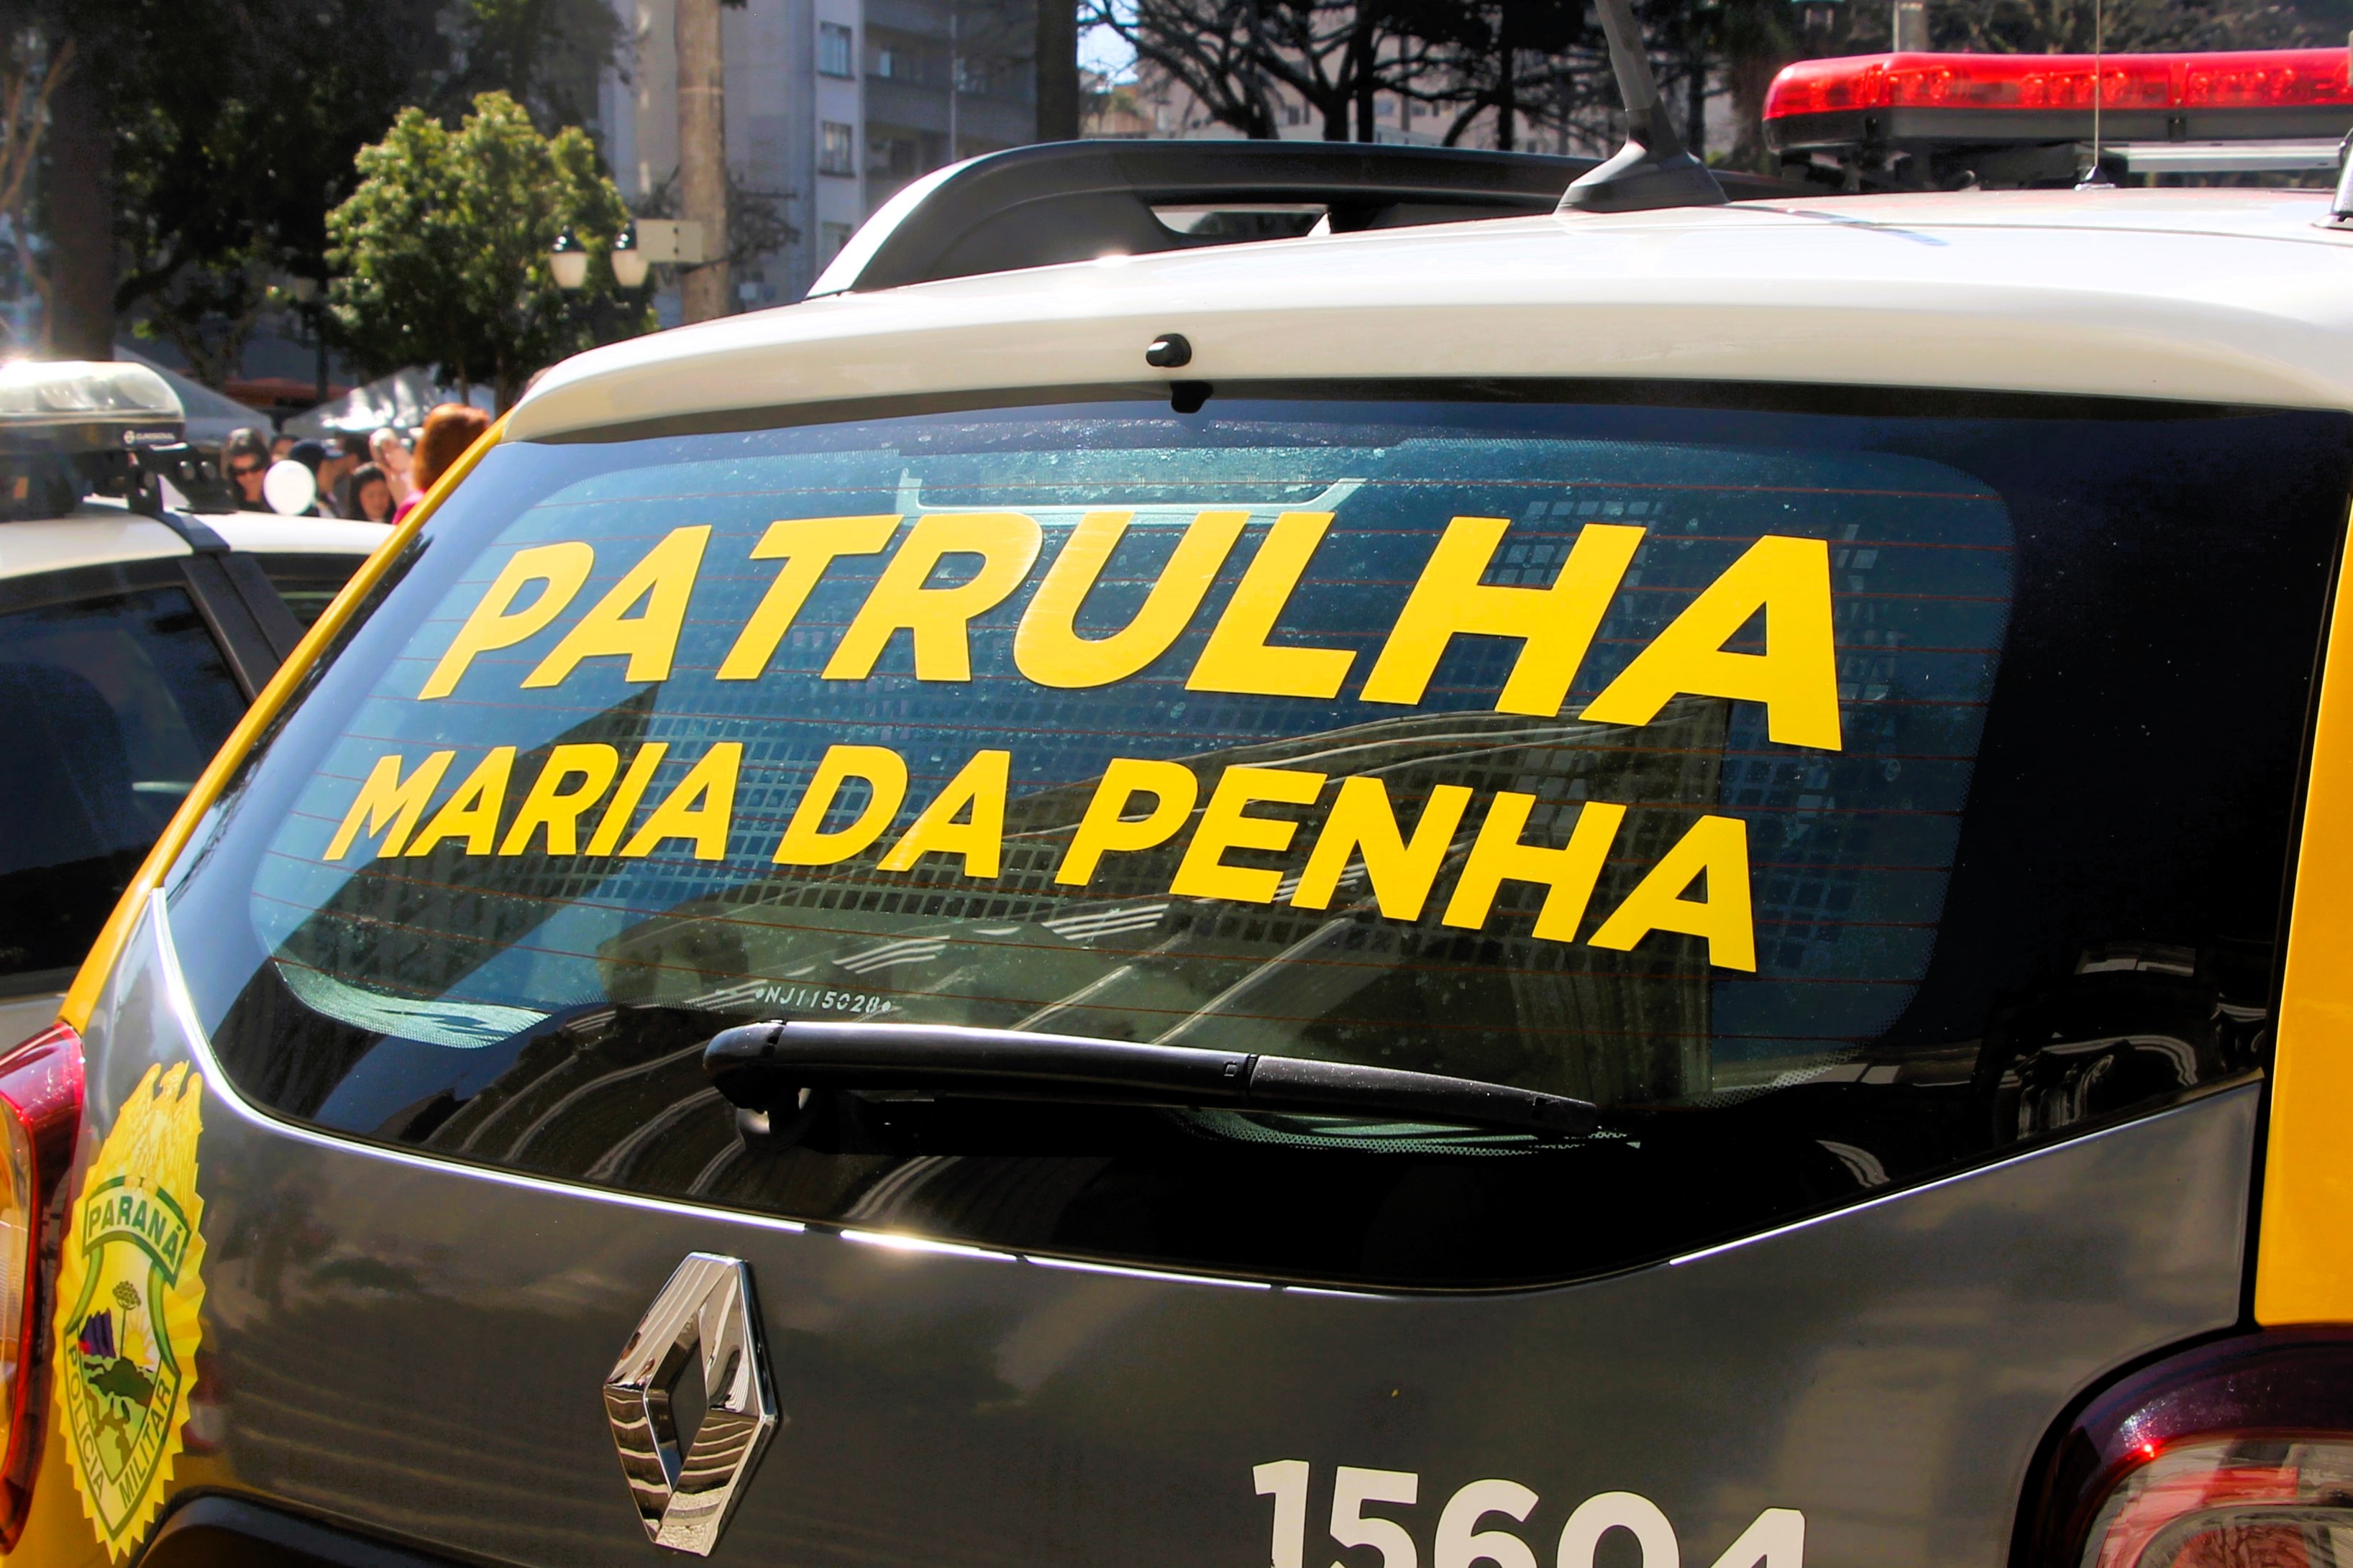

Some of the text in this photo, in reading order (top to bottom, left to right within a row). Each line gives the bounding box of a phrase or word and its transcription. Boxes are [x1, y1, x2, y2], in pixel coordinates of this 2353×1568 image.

[417, 511, 1842, 751] PATRULHA
[323, 742, 1757, 973] MARIA DA PENHA
[87, 1195, 183, 1267] PARANÁ
[118, 1377, 172, 1509] MILITAR
